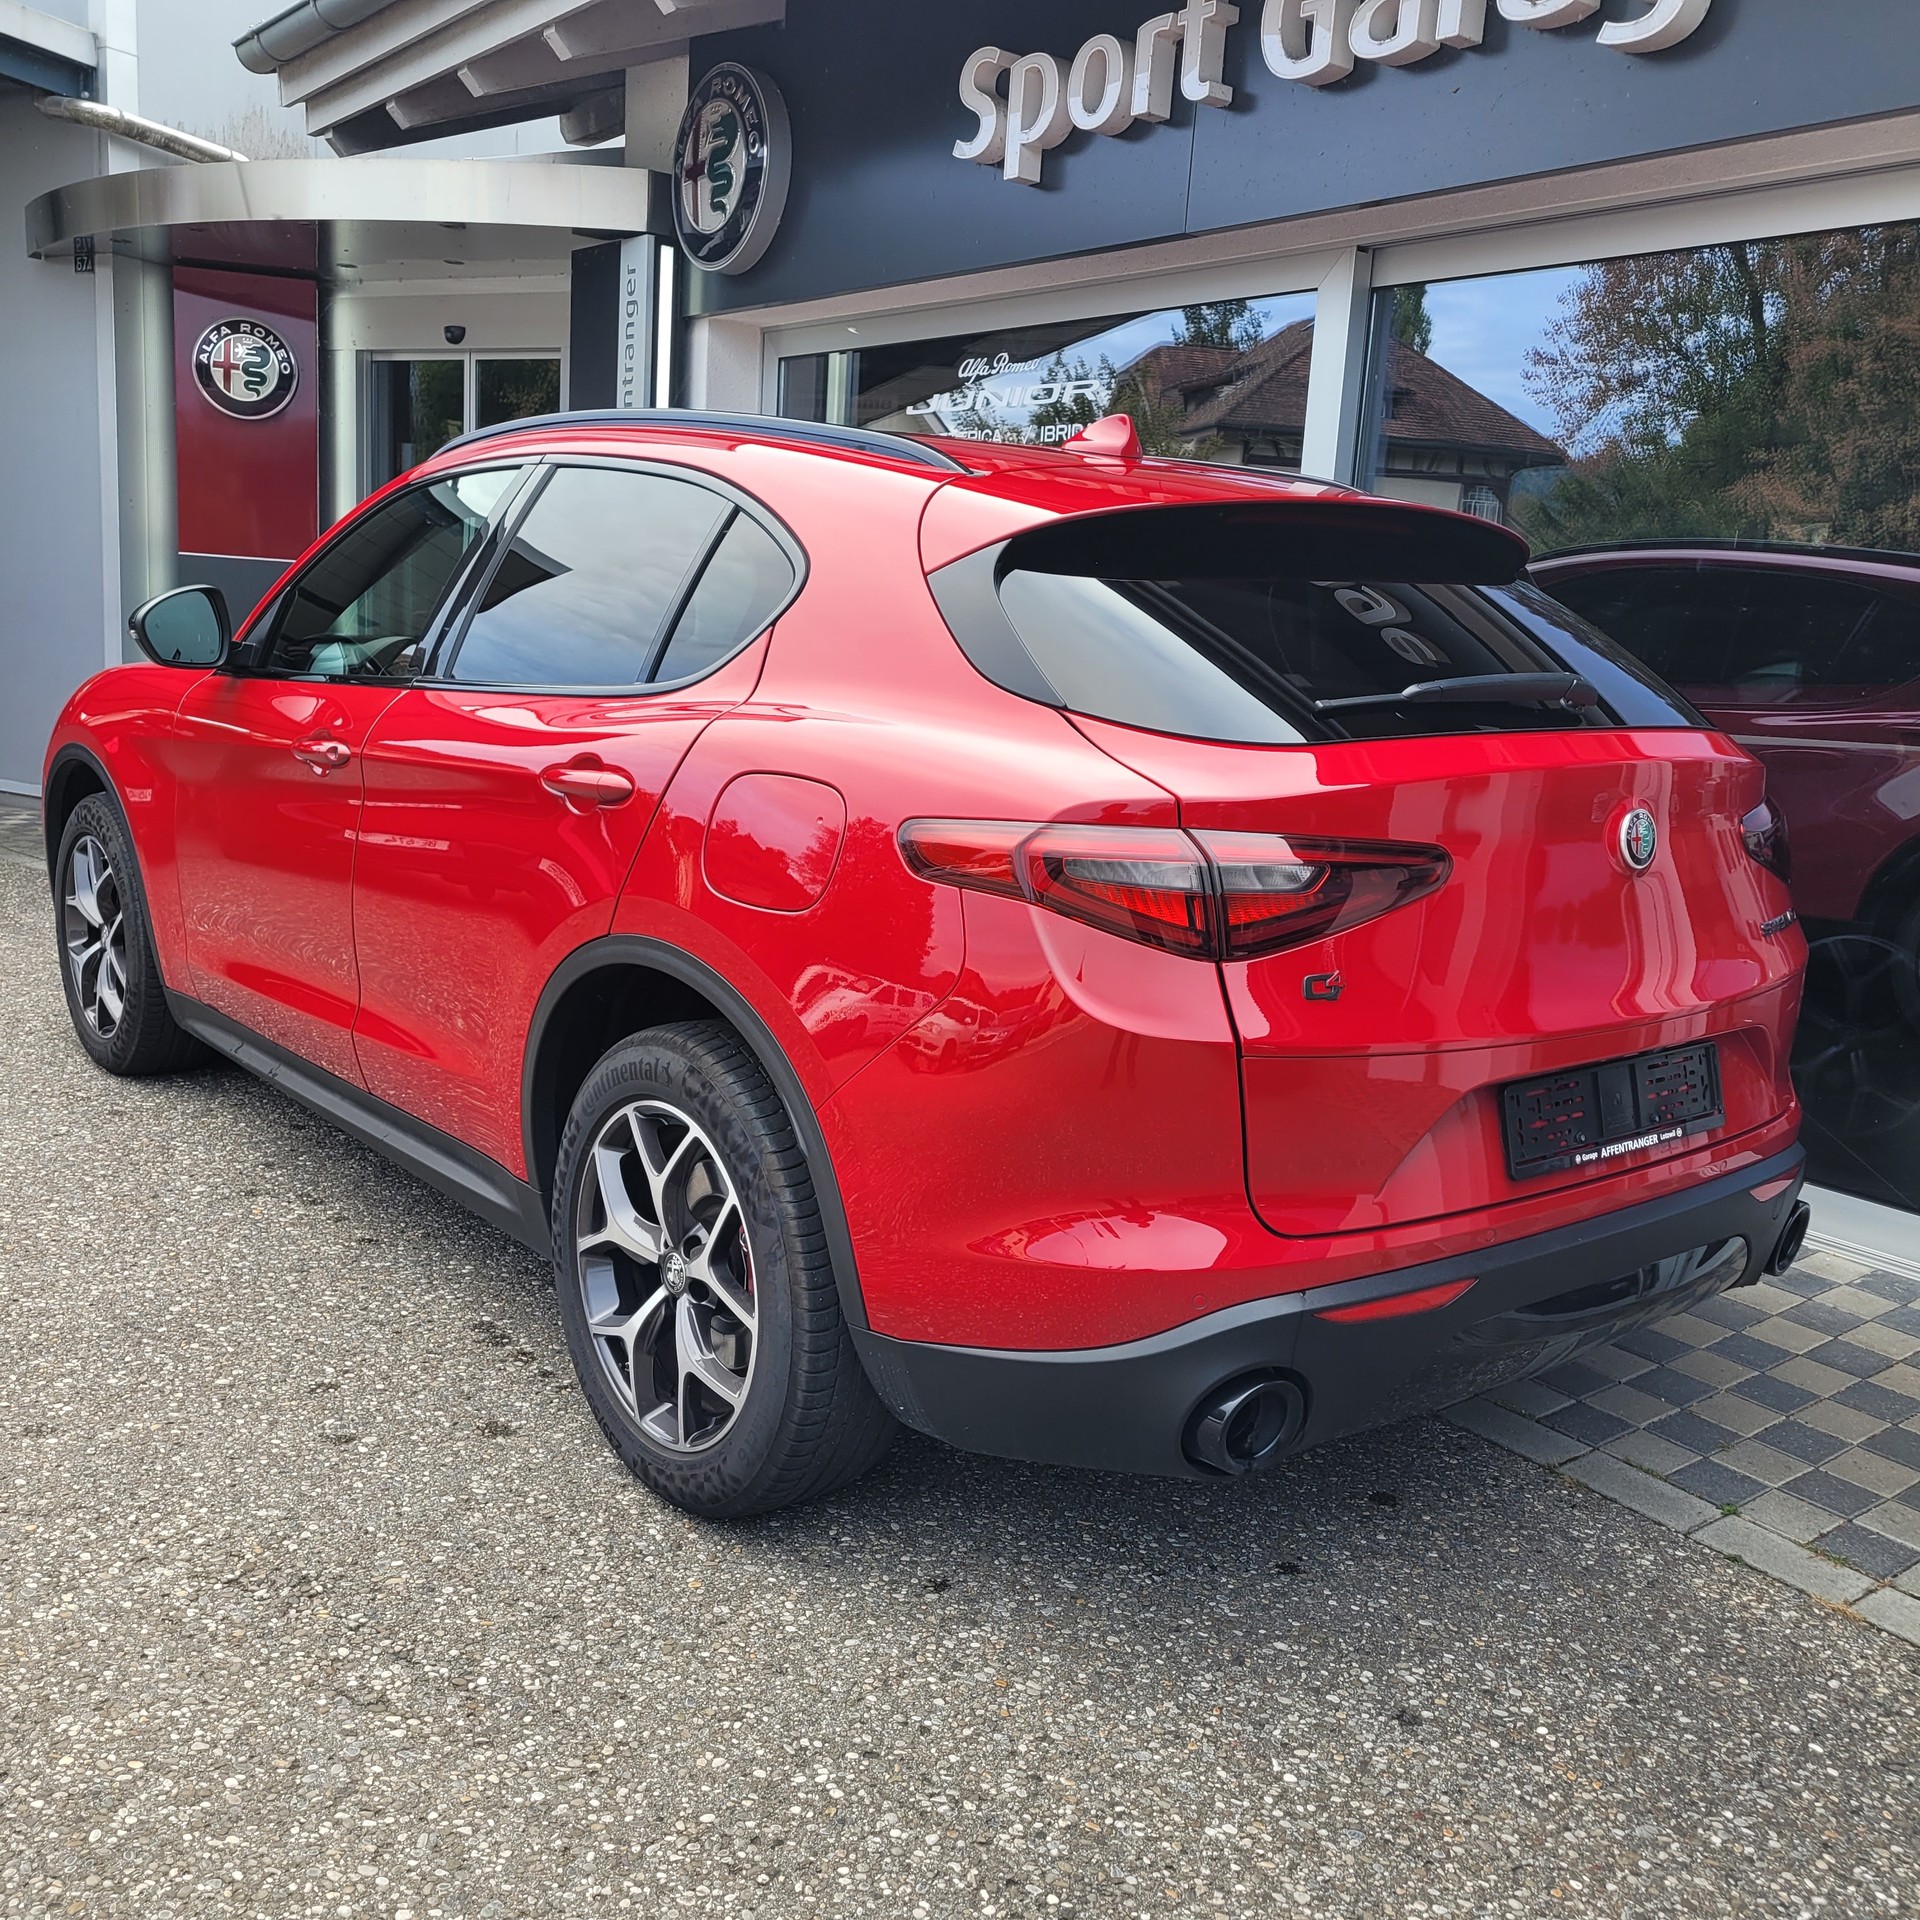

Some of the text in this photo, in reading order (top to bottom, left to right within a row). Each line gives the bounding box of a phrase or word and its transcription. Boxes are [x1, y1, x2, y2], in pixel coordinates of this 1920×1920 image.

[952, 0, 1240, 185] Sport
[709, 77, 761, 155] ROMEO
[198, 323, 292, 375] ALFA ROMEO
[958, 352, 1042, 385] Alfa Romeo
[905, 379, 1101, 416] JUNIOR
[1040, 422, 1092, 442] IBRID
[581, 1057, 660, 1117] Continental
[1600, 1134, 1659, 1159] AFFENTRANGER
